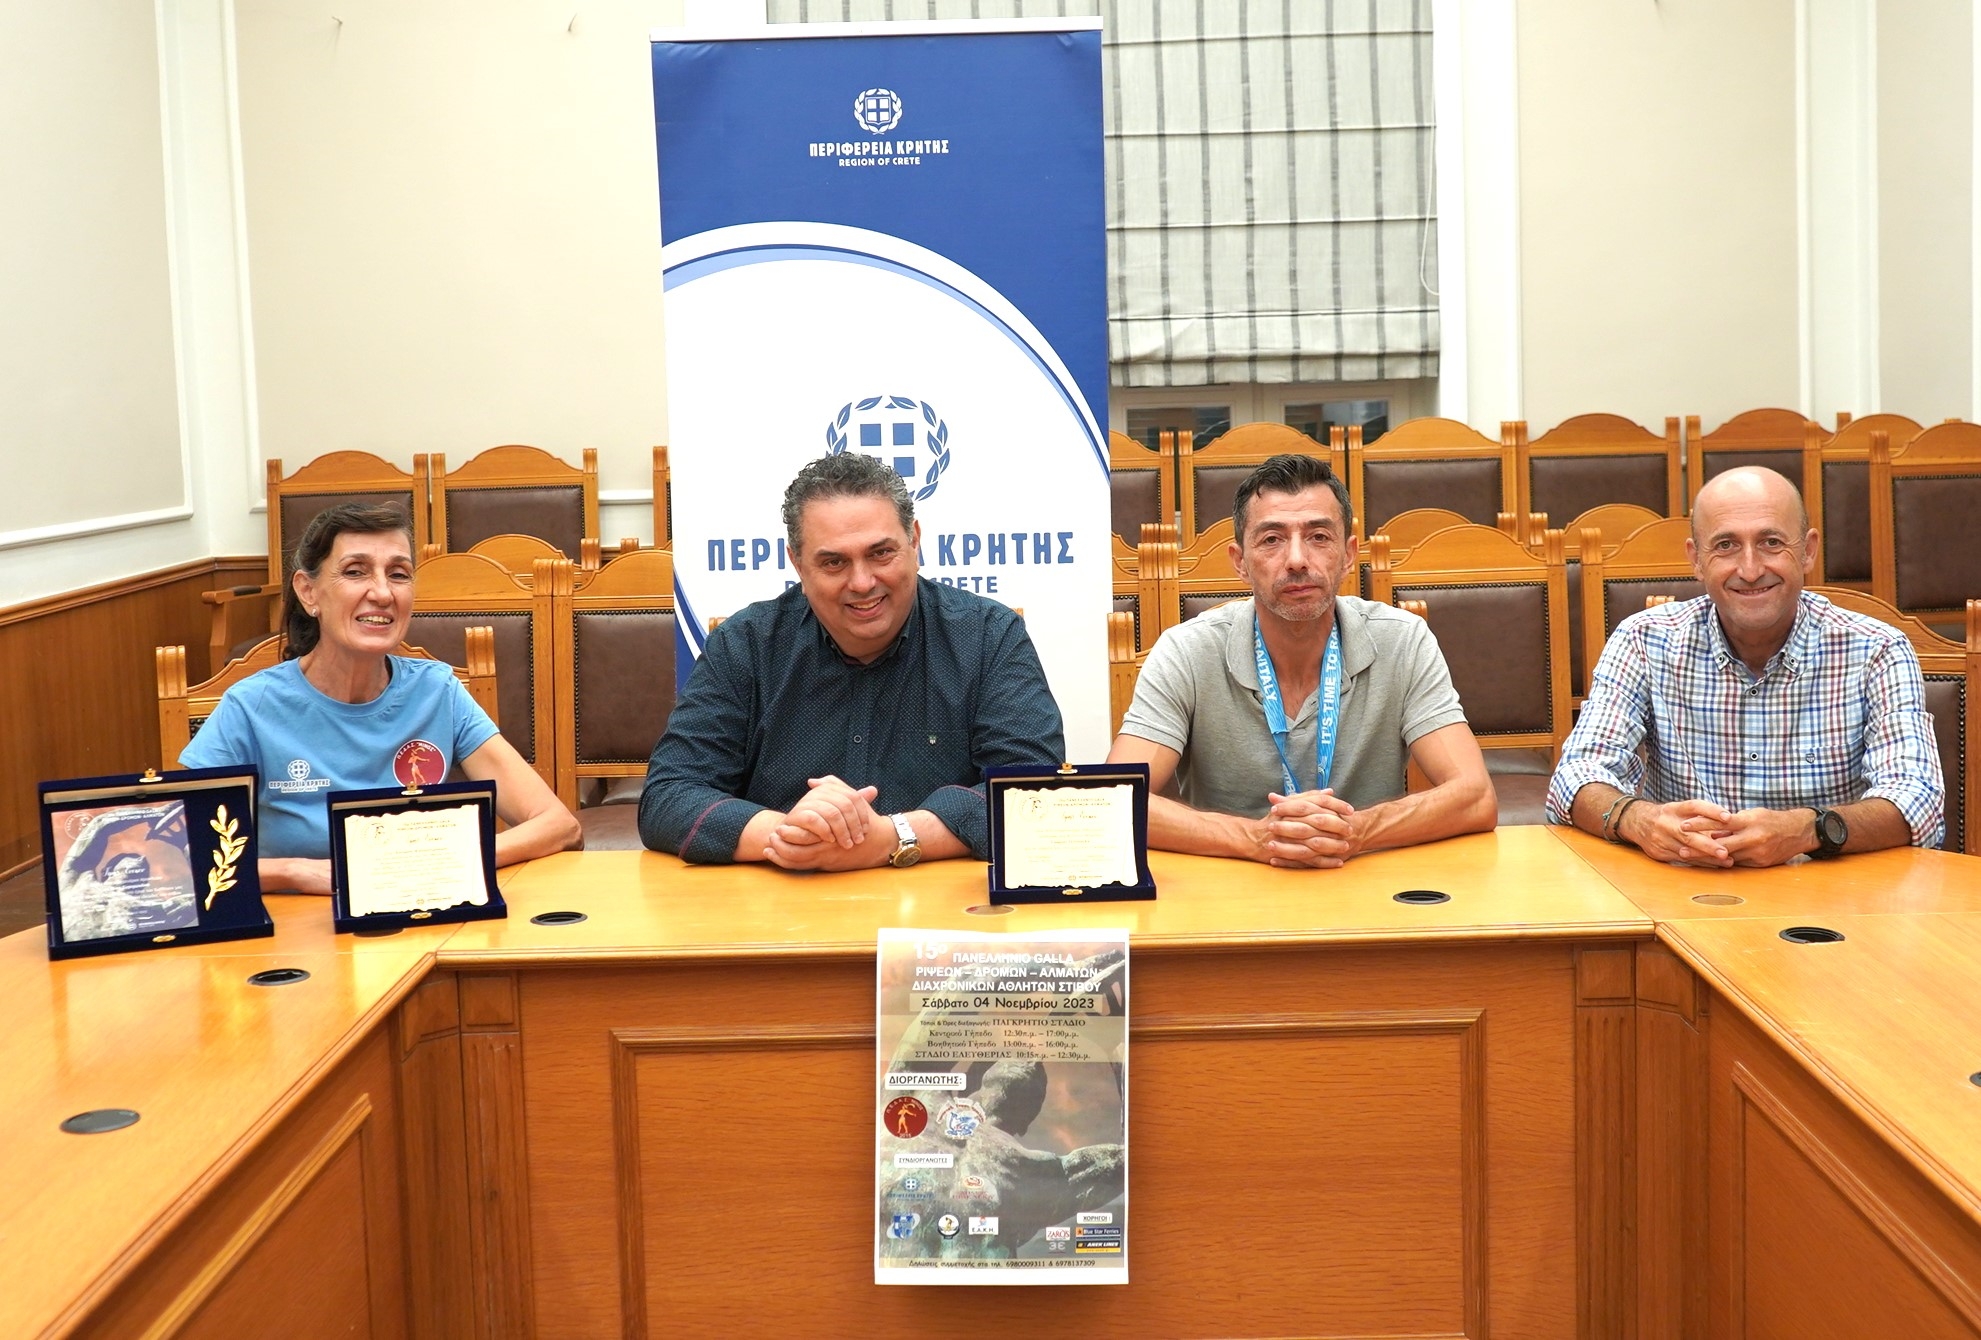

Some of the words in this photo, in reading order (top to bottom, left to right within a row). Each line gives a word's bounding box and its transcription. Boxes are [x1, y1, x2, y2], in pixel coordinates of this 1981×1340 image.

[809, 141, 893, 157] ΠΕΡΙΦΕΡΕΙΑ
[896, 139, 949, 155] ΚΡΗΤΗΣ
[839, 157, 875, 167] REGION
[877, 157, 890, 166] OF
[892, 157, 921, 166] CRETE
[938, 531, 1074, 566] ΚΡΗΤΗΣ
[1325, 653, 1338, 672] TO
[1323, 676, 1336, 713] TIME
[1321, 716, 1333, 744] IT'S
[953, 952, 1031, 964] ΠΑΝΕΛΛΗΝΙΟ
[1033, 952, 1074, 964] GALLA
[915, 966, 962, 978] ΡΙΨΕΩΝ
[974, 966, 1027, 978] ΔΡΟΜΩΝ
[1039, 967, 1098, 978] ΑΛΜΑΤΩΝ
[912, 981, 995, 992] ΔΙΑΧΡΟΝΙΚΩΝ
[997, 981, 1056, 992] ΑΘΛΗΤΩΝ
[1058, 982, 1102, 992] ΣΤΙΒΟΥ
[922, 998, 969, 1009] Σάββατο
[974, 997, 990, 1008] 04
[995, 997, 1058, 1010] Νοεμβρίου
[1063, 997, 1094, 1008] 2023
[992, 1018, 1048, 1026] ΠΑΓΚΡΗΤΙΟ
[929, 1030, 962, 1038] Κεντρικό
[964, 1030, 993, 1038] Γήπεδο
[927, 1040, 966, 1049] Βοηθητικό
[968, 1040, 996, 1049] Γήπεδο
[888, 1075, 962, 1085] ΔΙΟΡΓΑΝΩΤΗΣ:
